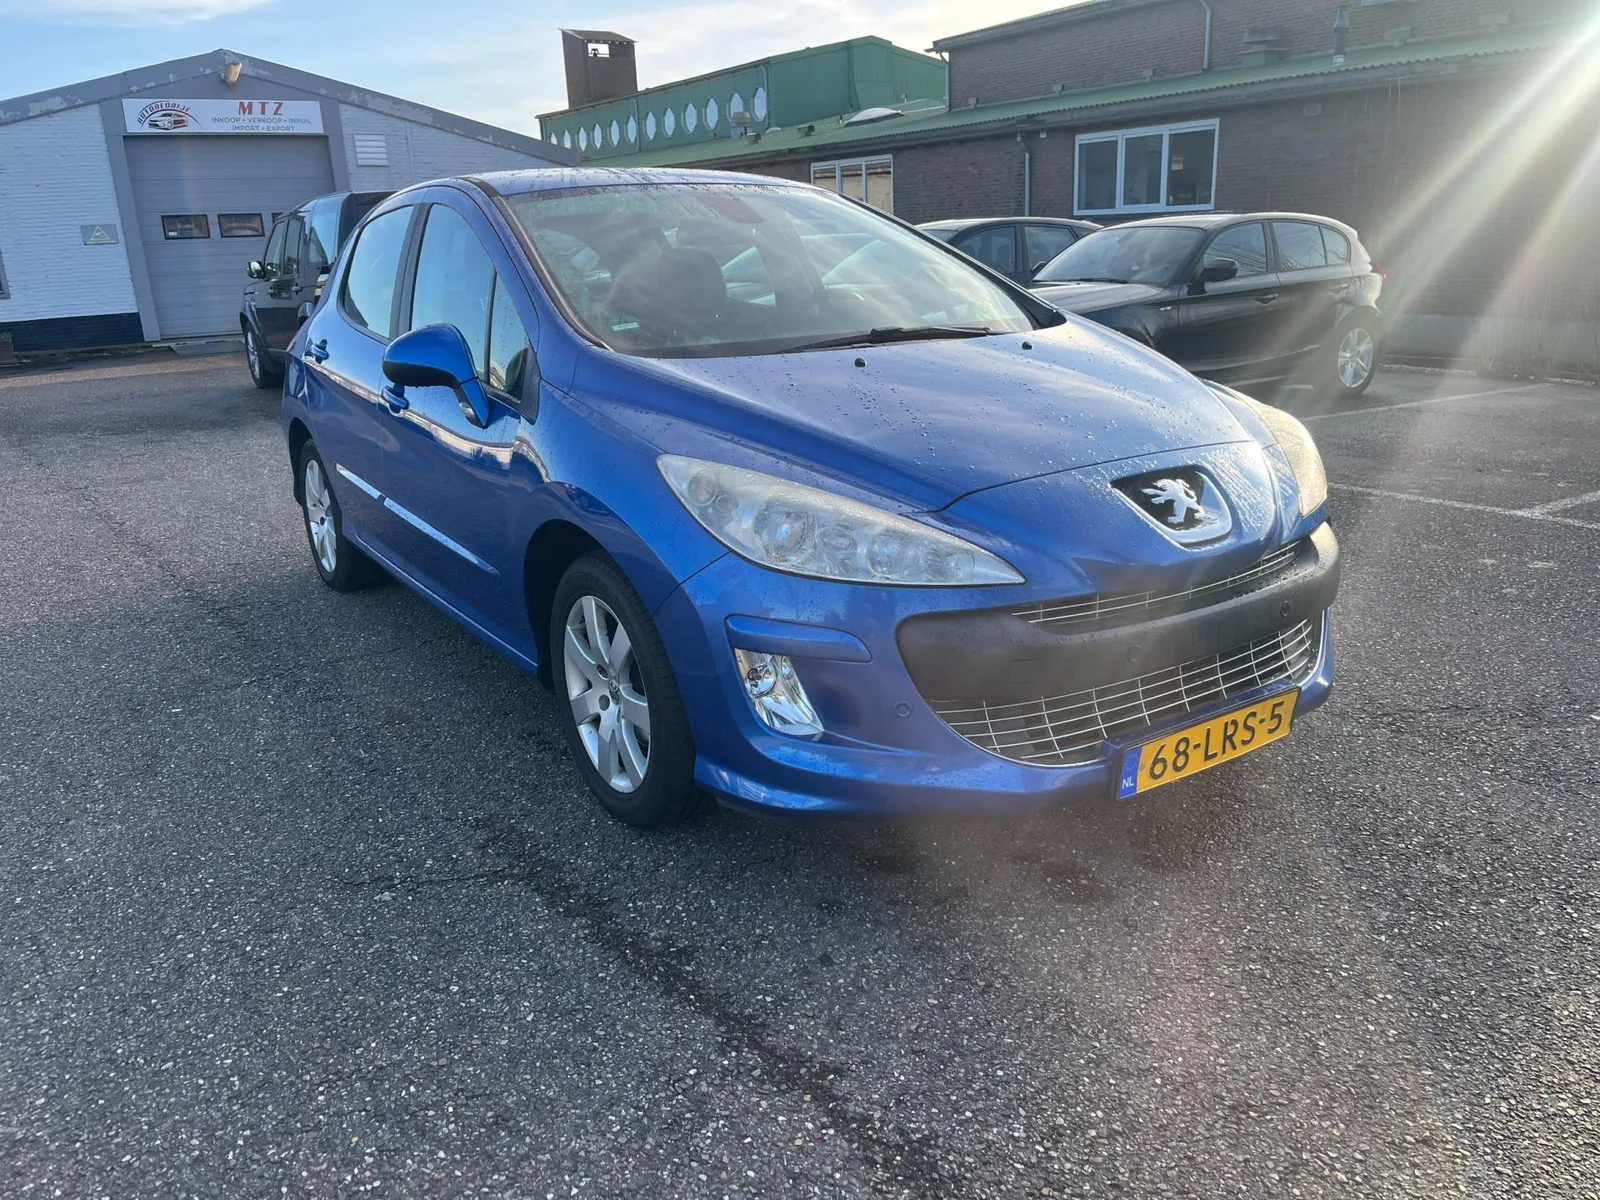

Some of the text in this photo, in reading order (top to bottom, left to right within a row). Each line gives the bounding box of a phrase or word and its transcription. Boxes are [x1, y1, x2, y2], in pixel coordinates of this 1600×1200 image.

[238, 101, 284, 116] MTZ
[1149, 700, 1285, 780] 68-LRS-5
[1121, 776, 1135, 789] NL
